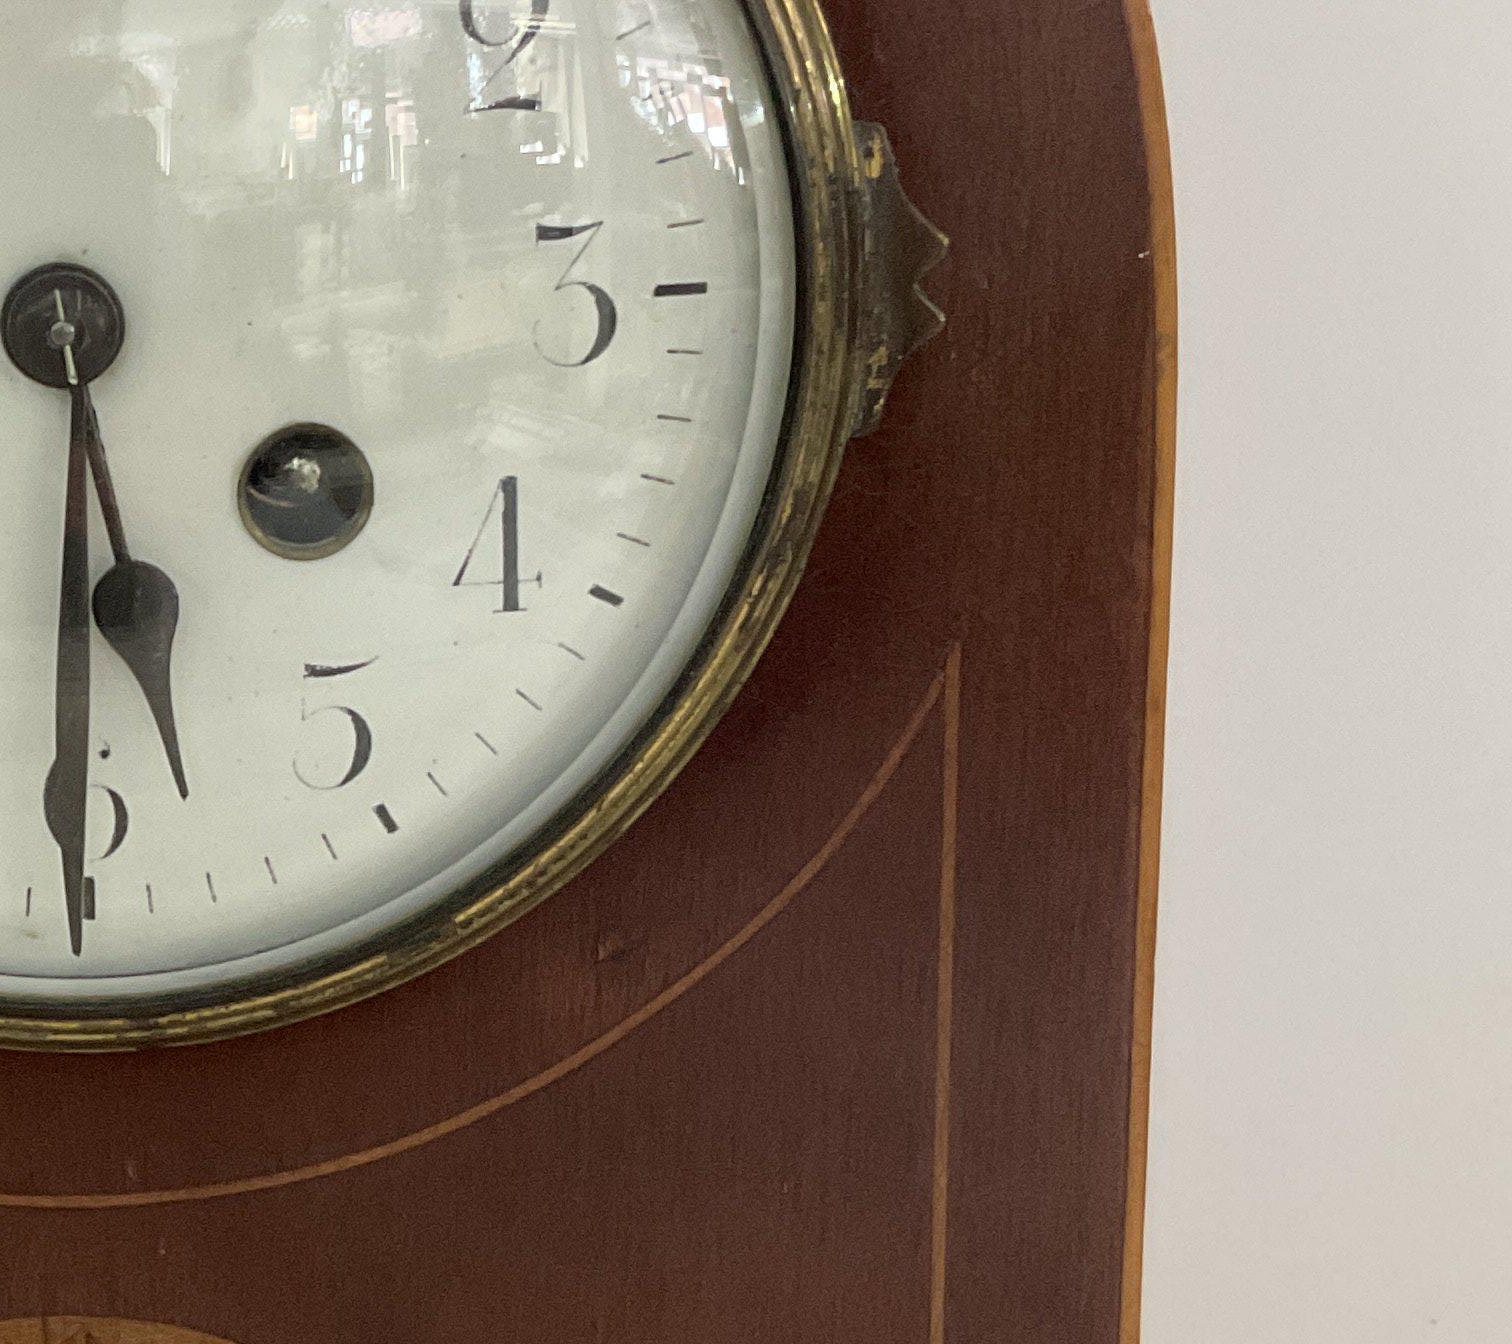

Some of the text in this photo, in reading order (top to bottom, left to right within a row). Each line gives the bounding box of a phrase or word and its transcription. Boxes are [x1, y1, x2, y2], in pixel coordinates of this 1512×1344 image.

[531, 220, 619, 368] 3
[452, 475, 545, 613] 4
[291, 655, 380, 791] 5
